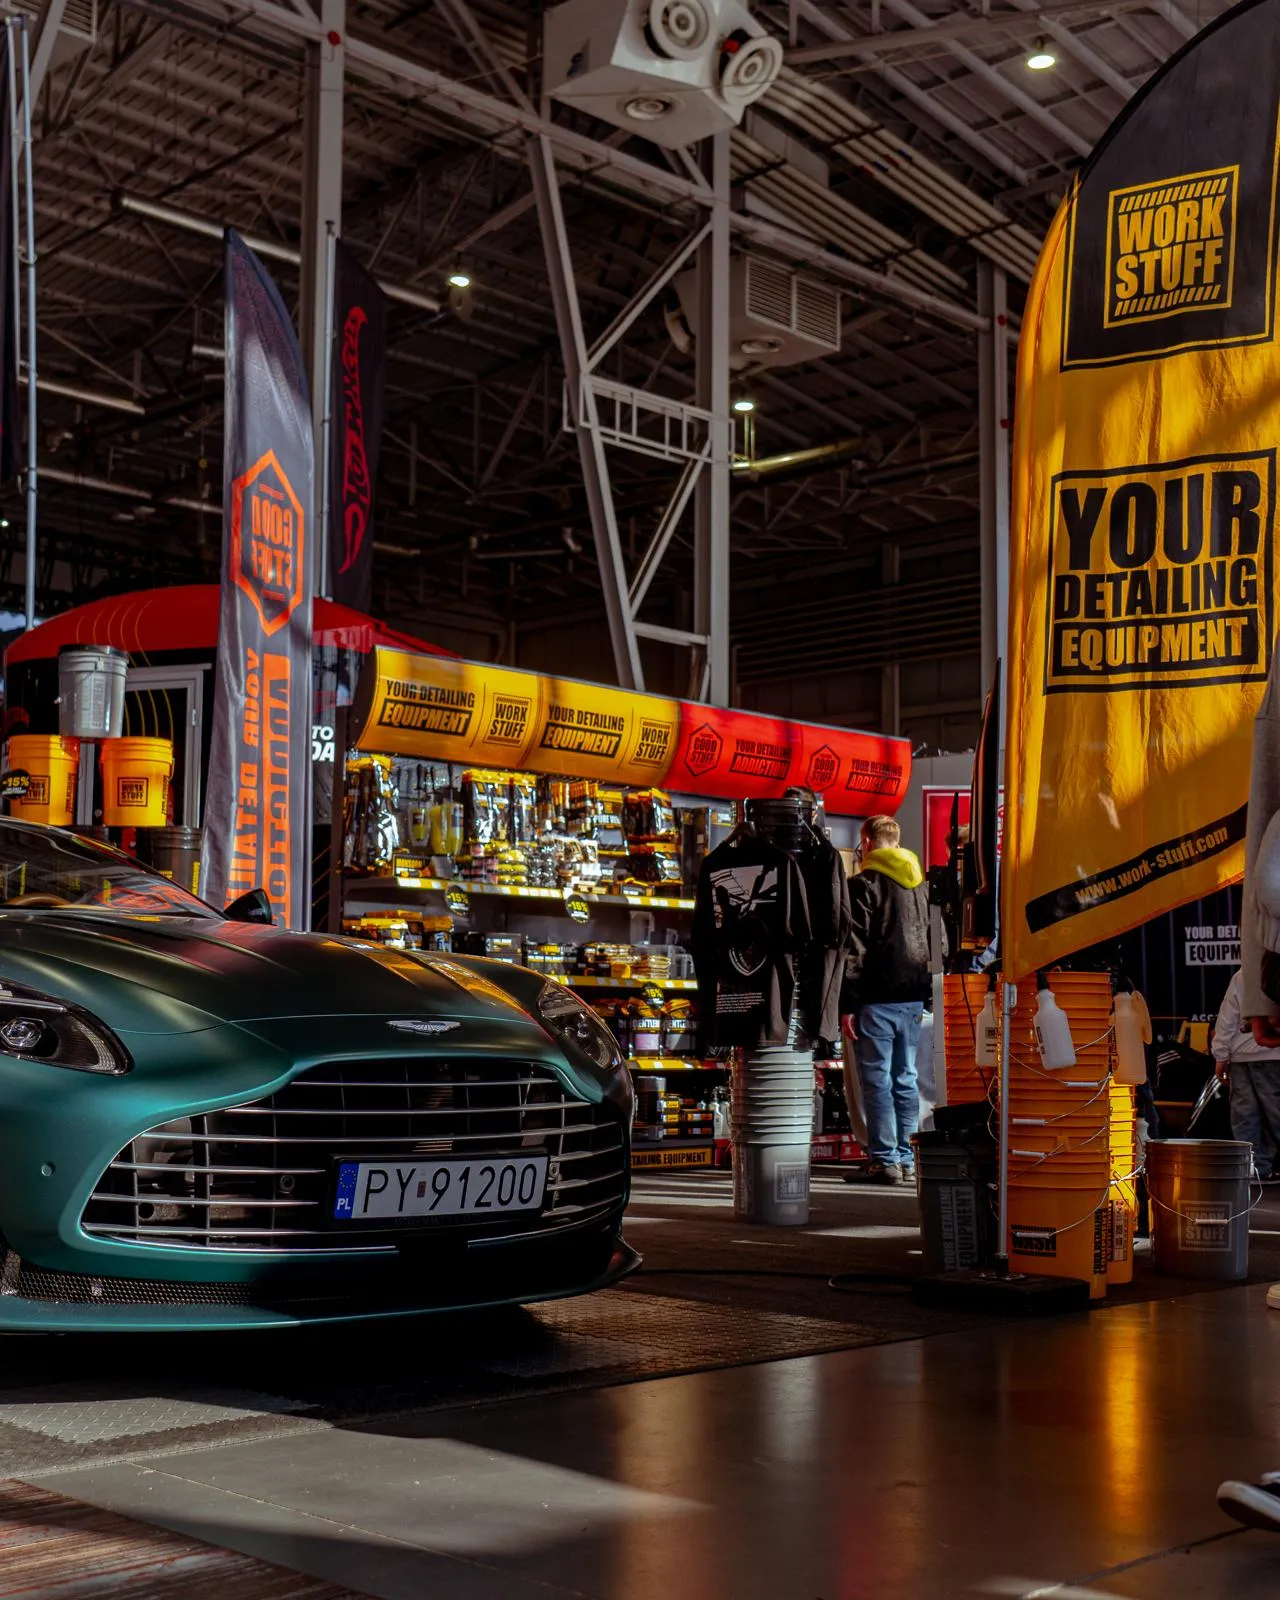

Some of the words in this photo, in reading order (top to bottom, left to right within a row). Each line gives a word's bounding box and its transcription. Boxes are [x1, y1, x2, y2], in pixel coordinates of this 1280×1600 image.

[1118, 195, 1226, 256] WORK
[1115, 241, 1223, 300] STUFF
[1060, 470, 1260, 570] YOUR
[1055, 557, 1258, 620] DETAILING
[1060, 617, 1248, 668] EQUIPMENT
[385, 679, 417, 700] YOUR
[419, 685, 475, 707] DETAILING
[382, 703, 469, 734] EQUIPMENT
[495, 703, 528, 721] WORK
[548, 705, 575, 722] YOUR
[577, 710, 625, 731] DETAILING
[490, 720, 526, 739] STUFF
[641, 725, 669, 744] WORK
[544, 726, 619, 755] EQUIPMENT
[694, 737, 717, 752] GOOD
[735, 738, 756, 752] YOUR
[756, 741, 793, 760] DETAILING
[636, 743, 668, 760] STUFF
[690, 749, 715, 764] STUFF
[734, 755, 789, 778] ADDICTION
[814, 758, 834, 772] GOOD
[851, 759, 870, 772] YOUR
[2, 775, 30, 787] -15%
[811, 770, 833, 783] STUFF
[848, 775, 899, 794] ADDICTION
[121, 792, 144, 800] STUFF
[122, 783, 144, 792] WORK
[1075, 824, 1229, 905] www.work-stuff.com
[446, 892, 469, 904] -15%
[567, 900, 588, 913] -15%
[1184, 926, 1214, 940] YOUR
[664, 1151, 706, 1165] EQUIPMENT
[362, 1168, 416, 1213] PY
[428, 1163, 538, 1211] 91200
[337, 1198, 351, 1211] PL
[955, 1190, 976, 1268] EQUIPMENT
[1185, 1226, 1225, 1241] STUFF
